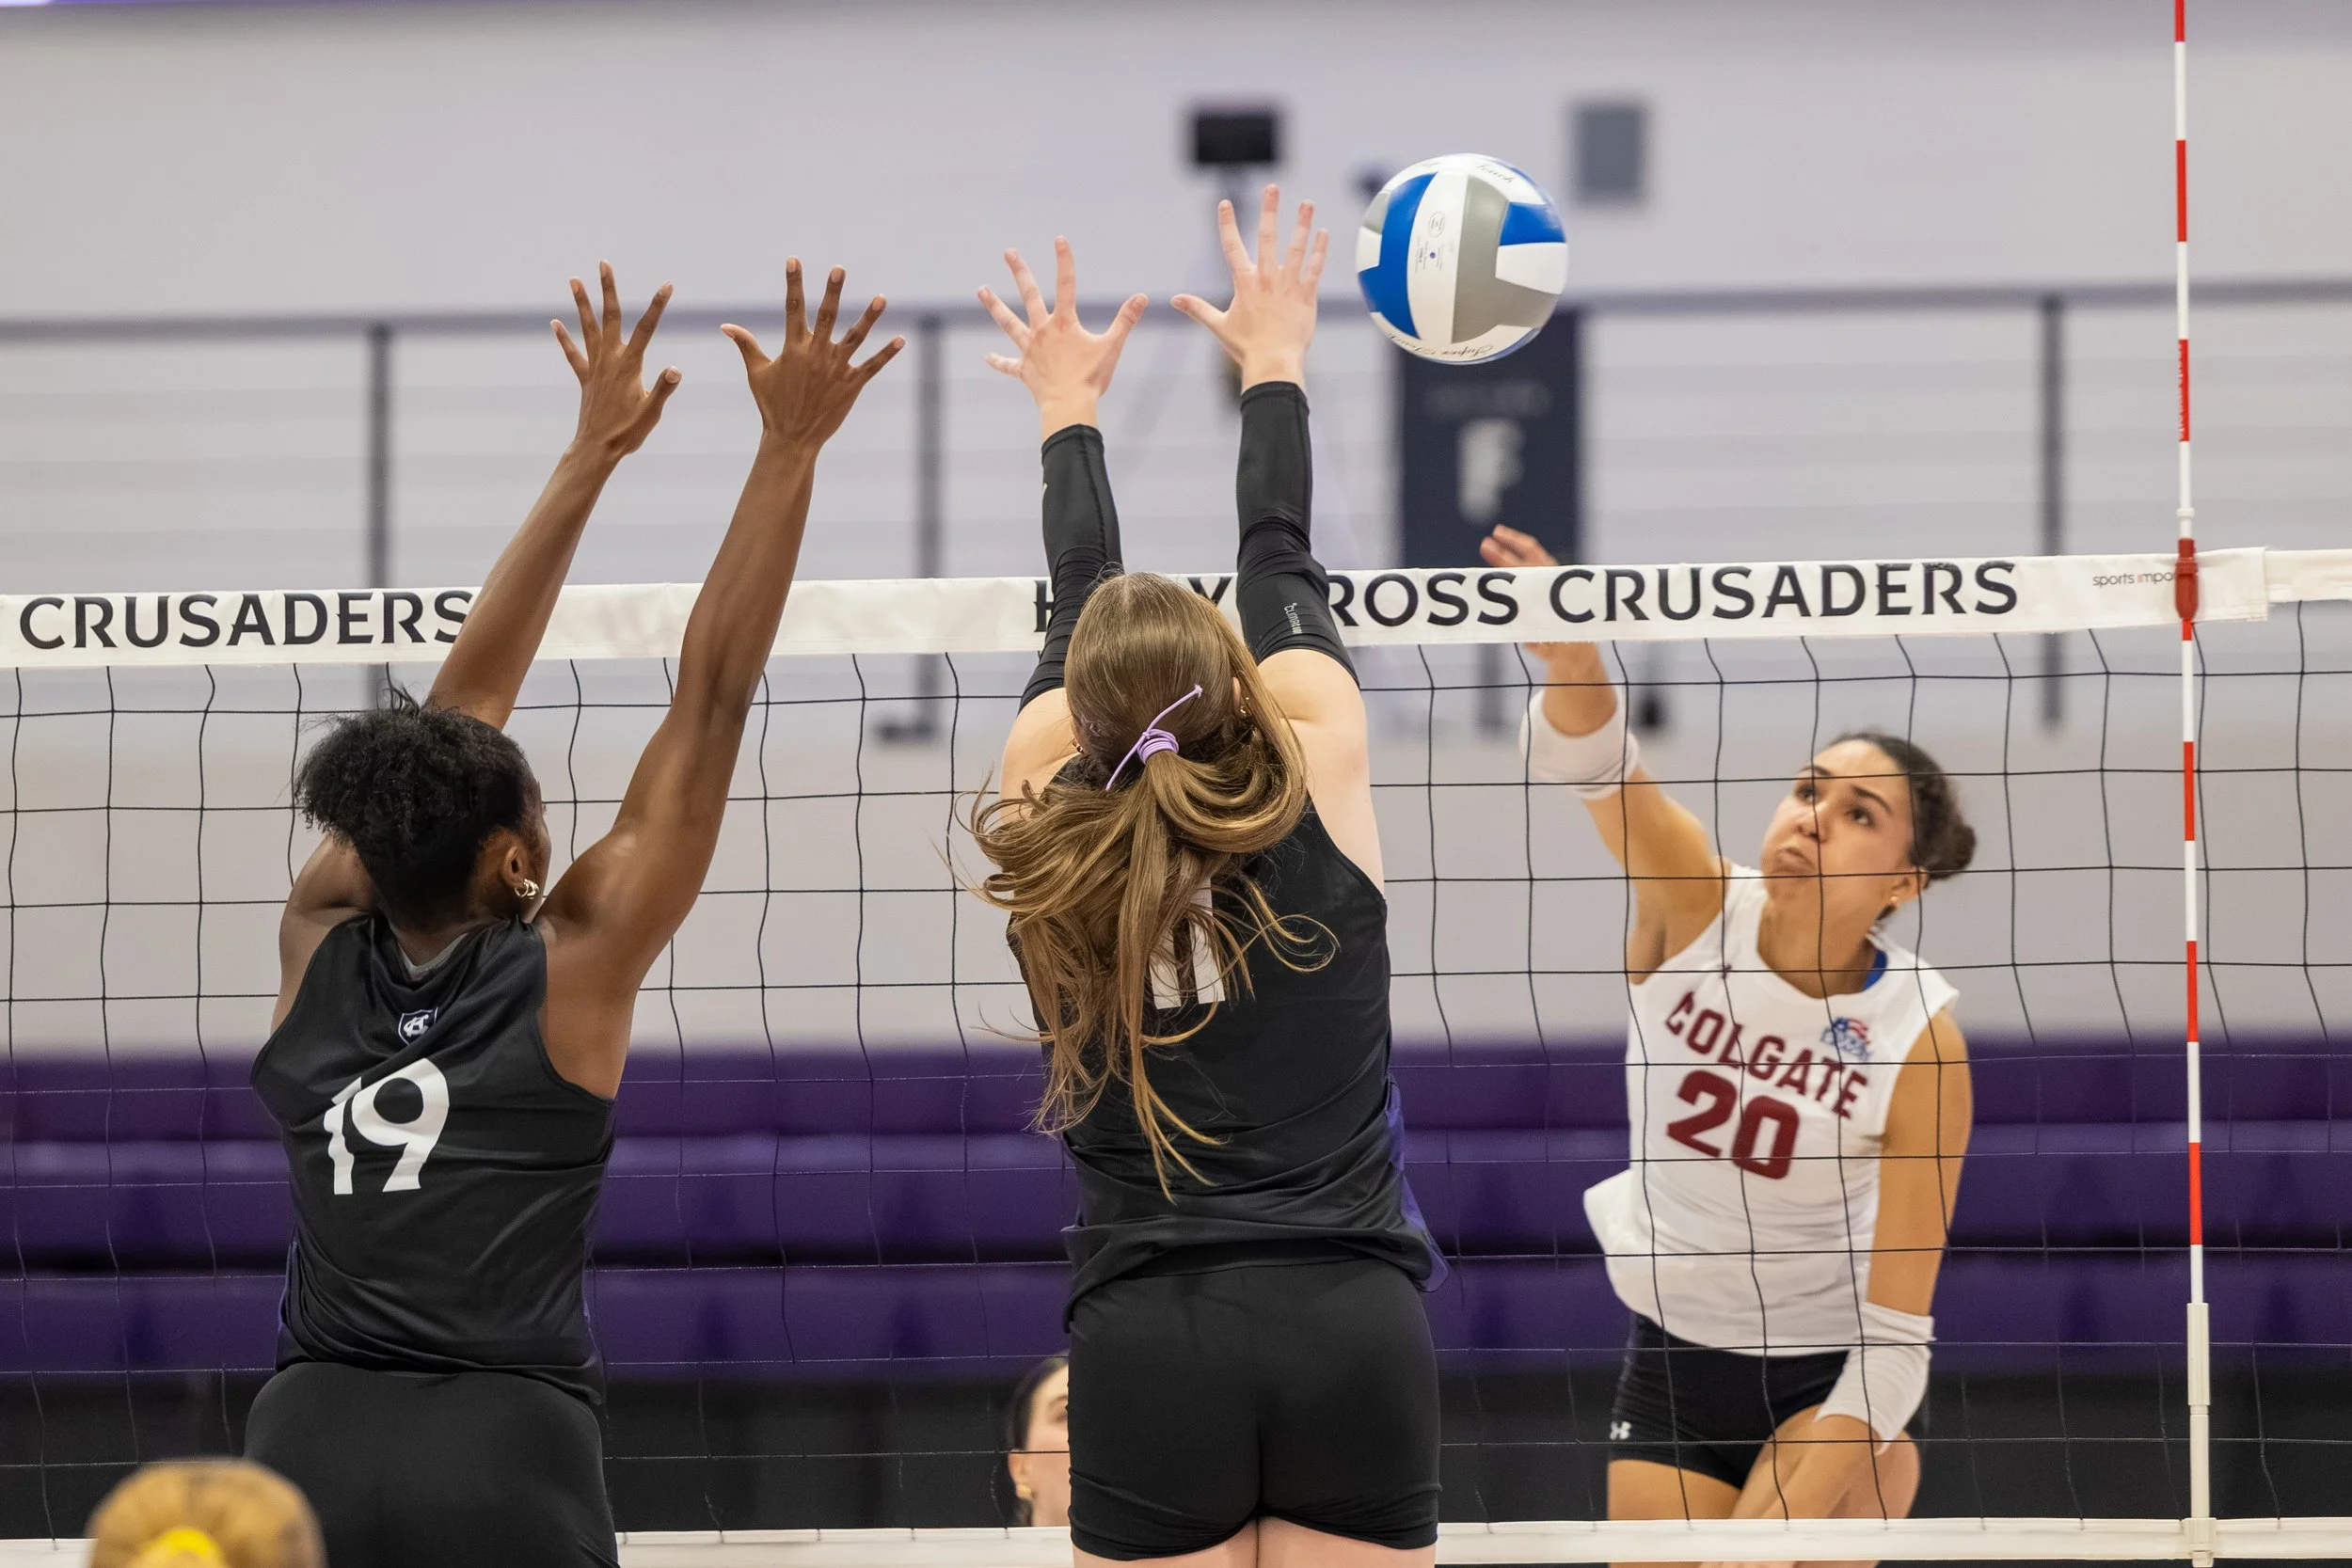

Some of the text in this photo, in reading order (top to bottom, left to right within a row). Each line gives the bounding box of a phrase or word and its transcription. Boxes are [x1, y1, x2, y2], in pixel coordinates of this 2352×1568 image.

[20, 591, 474, 649] CRUSADERS
[1327, 572, 1519, 627] ROSS
[1549, 561, 2017, 623] CRUSADERS
[2092, 574, 2135, 588] sports
[1663, 990, 1868, 1120] COLGATE
[324, 1057, 450, 1196] 19
[1665, 1069, 1801, 1180] 20
